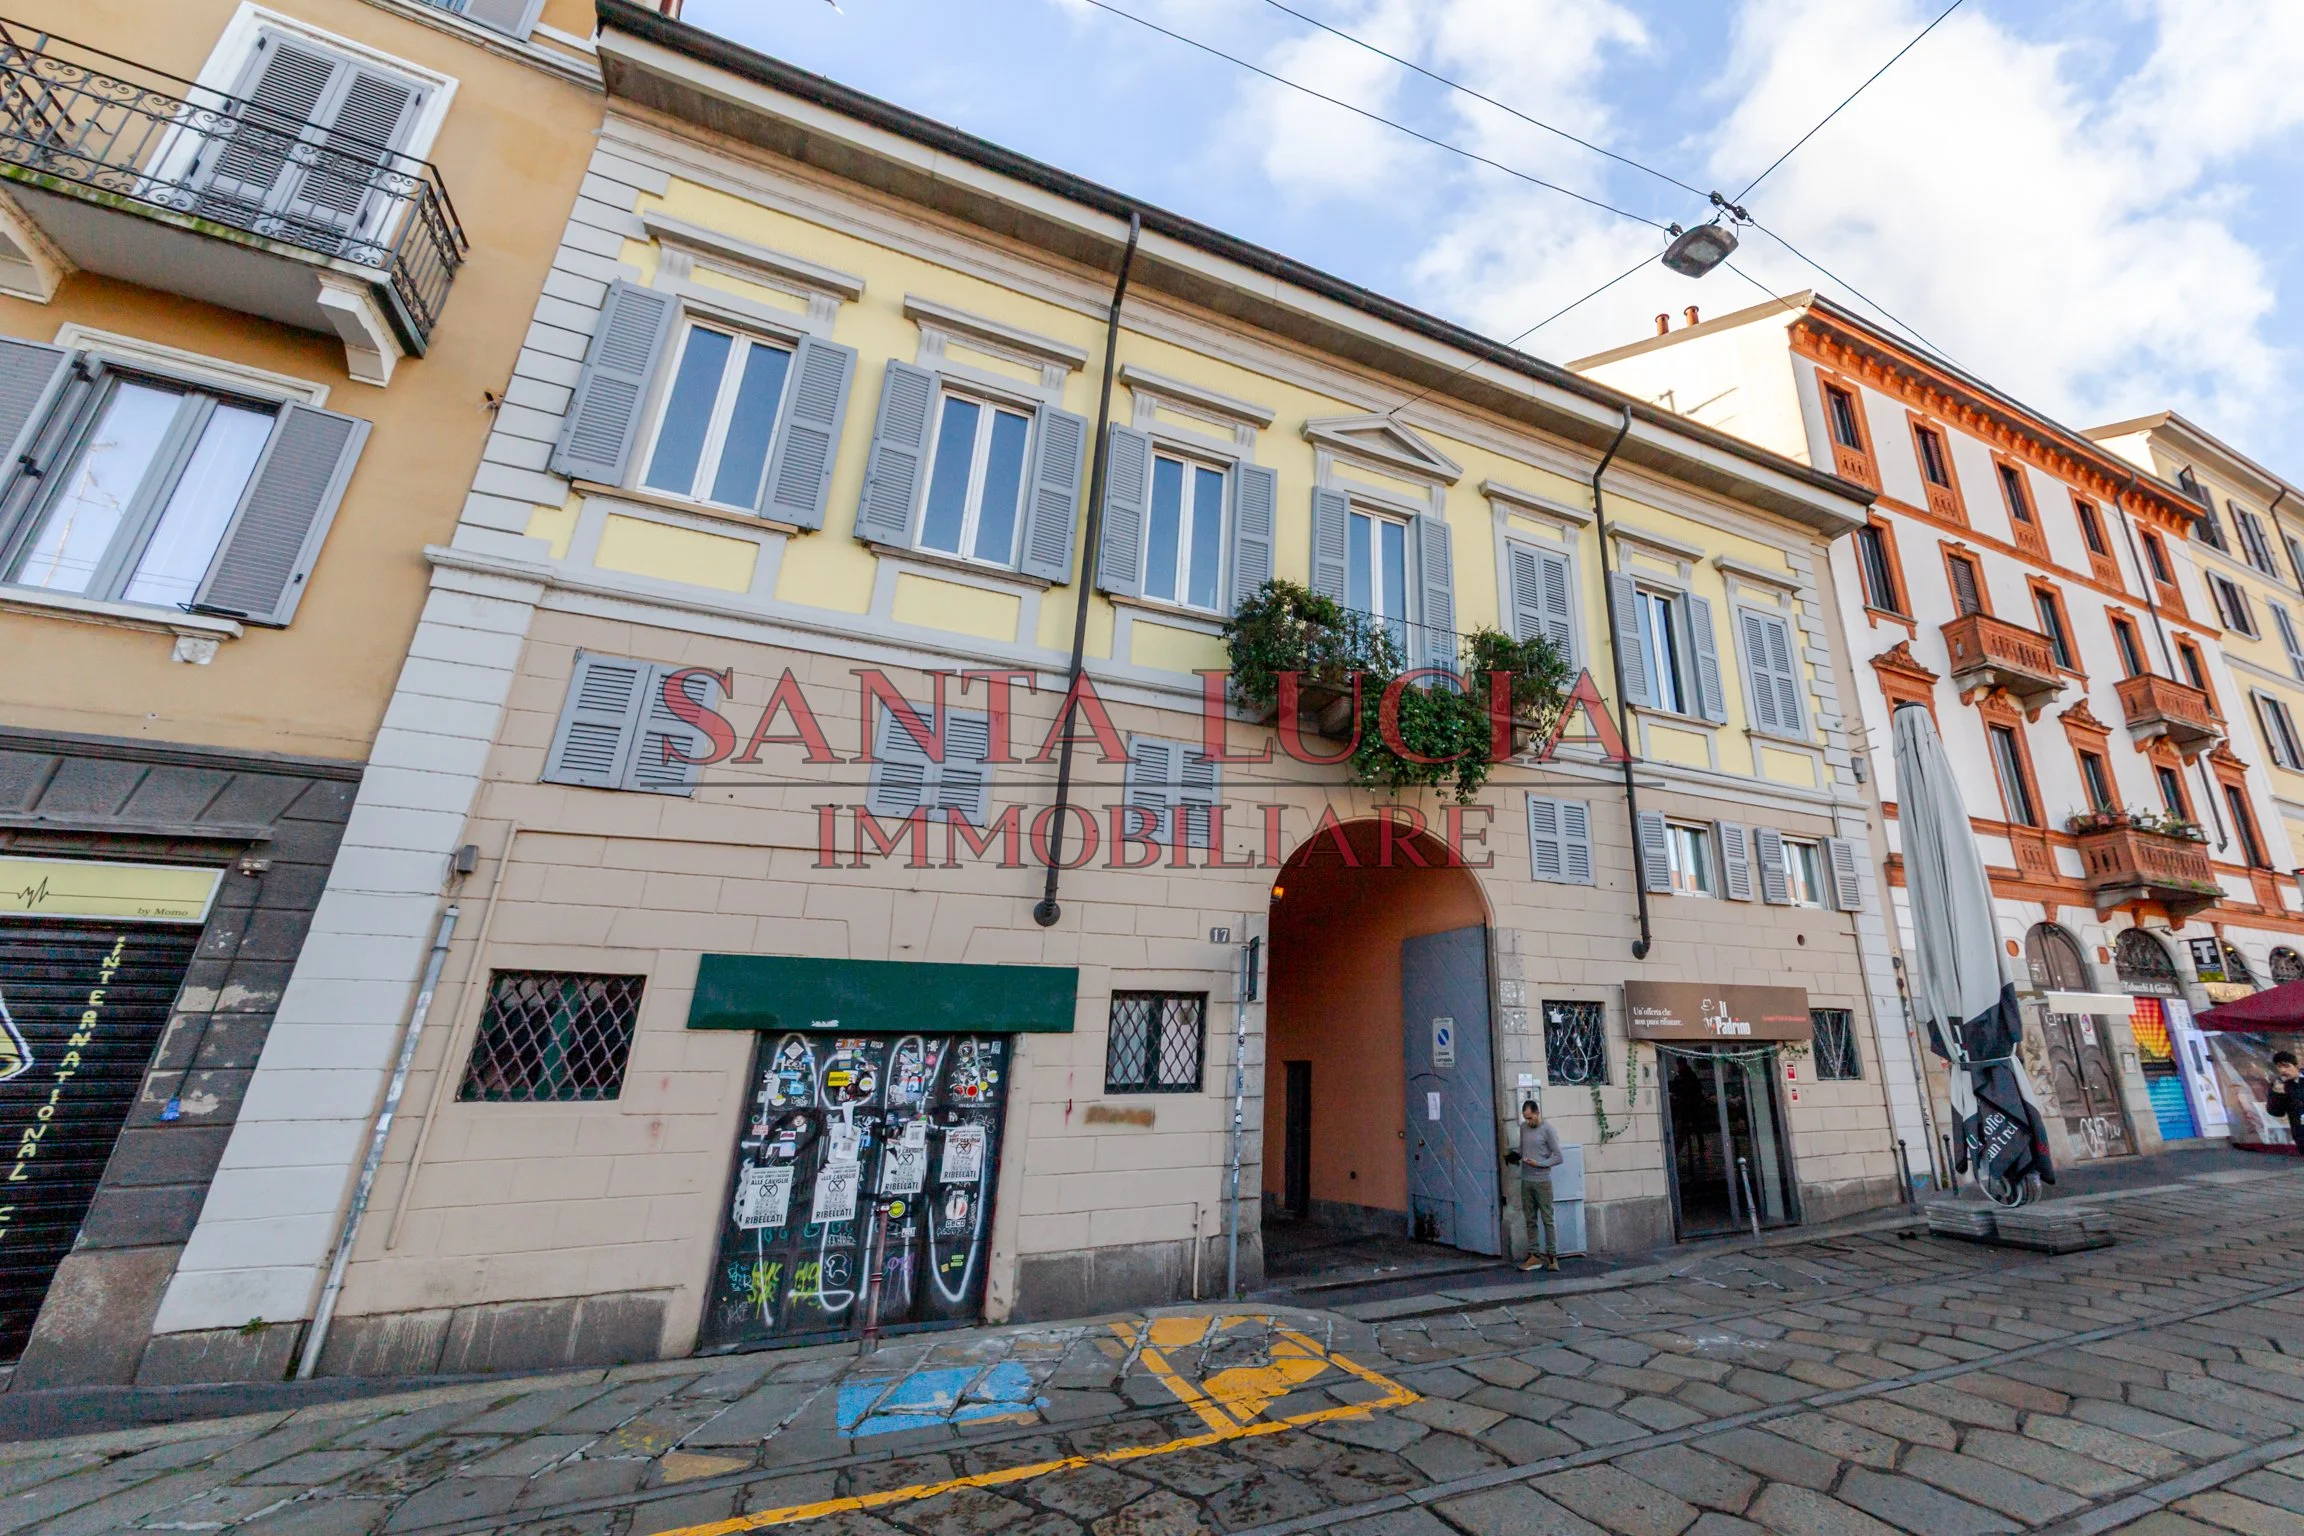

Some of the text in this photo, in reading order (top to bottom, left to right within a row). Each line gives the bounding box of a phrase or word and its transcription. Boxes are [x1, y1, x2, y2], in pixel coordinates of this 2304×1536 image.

[137, 907, 189, 916] by Momo
[1214, 928, 1229, 942] 17
[1715, 1016, 1751, 1035] Padrino
[944, 1170, 977, 1179] RIBELLATI
[885, 1181, 919, 1191] RIBELLATI
[816, 1208, 852, 1219] RIBELLATI
[745, 1214, 784, 1225] RIBELLATI
